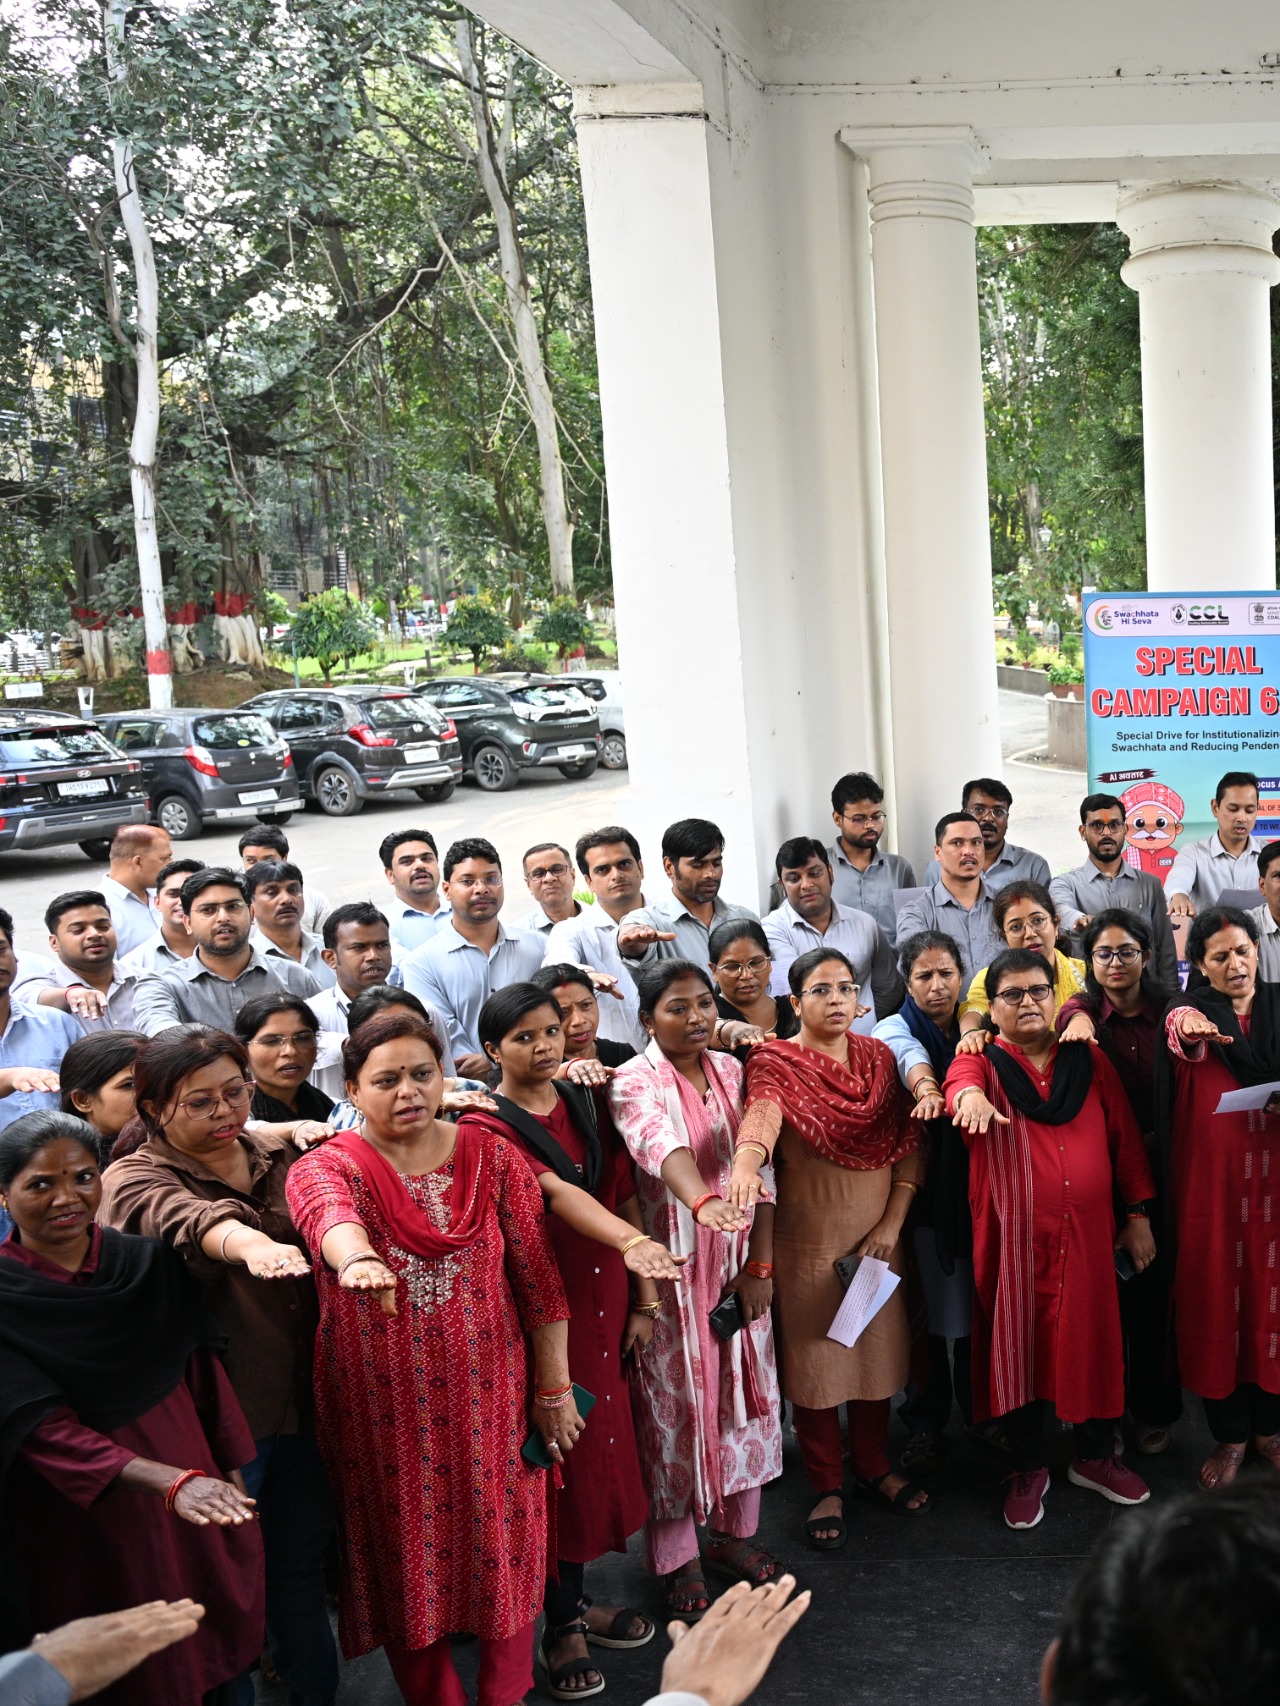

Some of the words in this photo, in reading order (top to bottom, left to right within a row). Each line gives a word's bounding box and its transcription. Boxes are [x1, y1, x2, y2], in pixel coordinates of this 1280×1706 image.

[1114, 610, 1159, 618] Swachhata
[1189, 604, 1229, 620] CCL
[1136, 646, 1262, 675] SPECIAL
[1091, 687, 1249, 717] CAMPAIGN
[1116, 731, 1153, 741] Special
[1156, 731, 1182, 740] Drive
[1185, 731, 1200, 739] for
[1112, 743, 1167, 752] Swachhata
[1169, 743, 1190, 751] and
[1191, 743, 1239, 752] Reducing
[1110, 773, 1118, 781] AI
